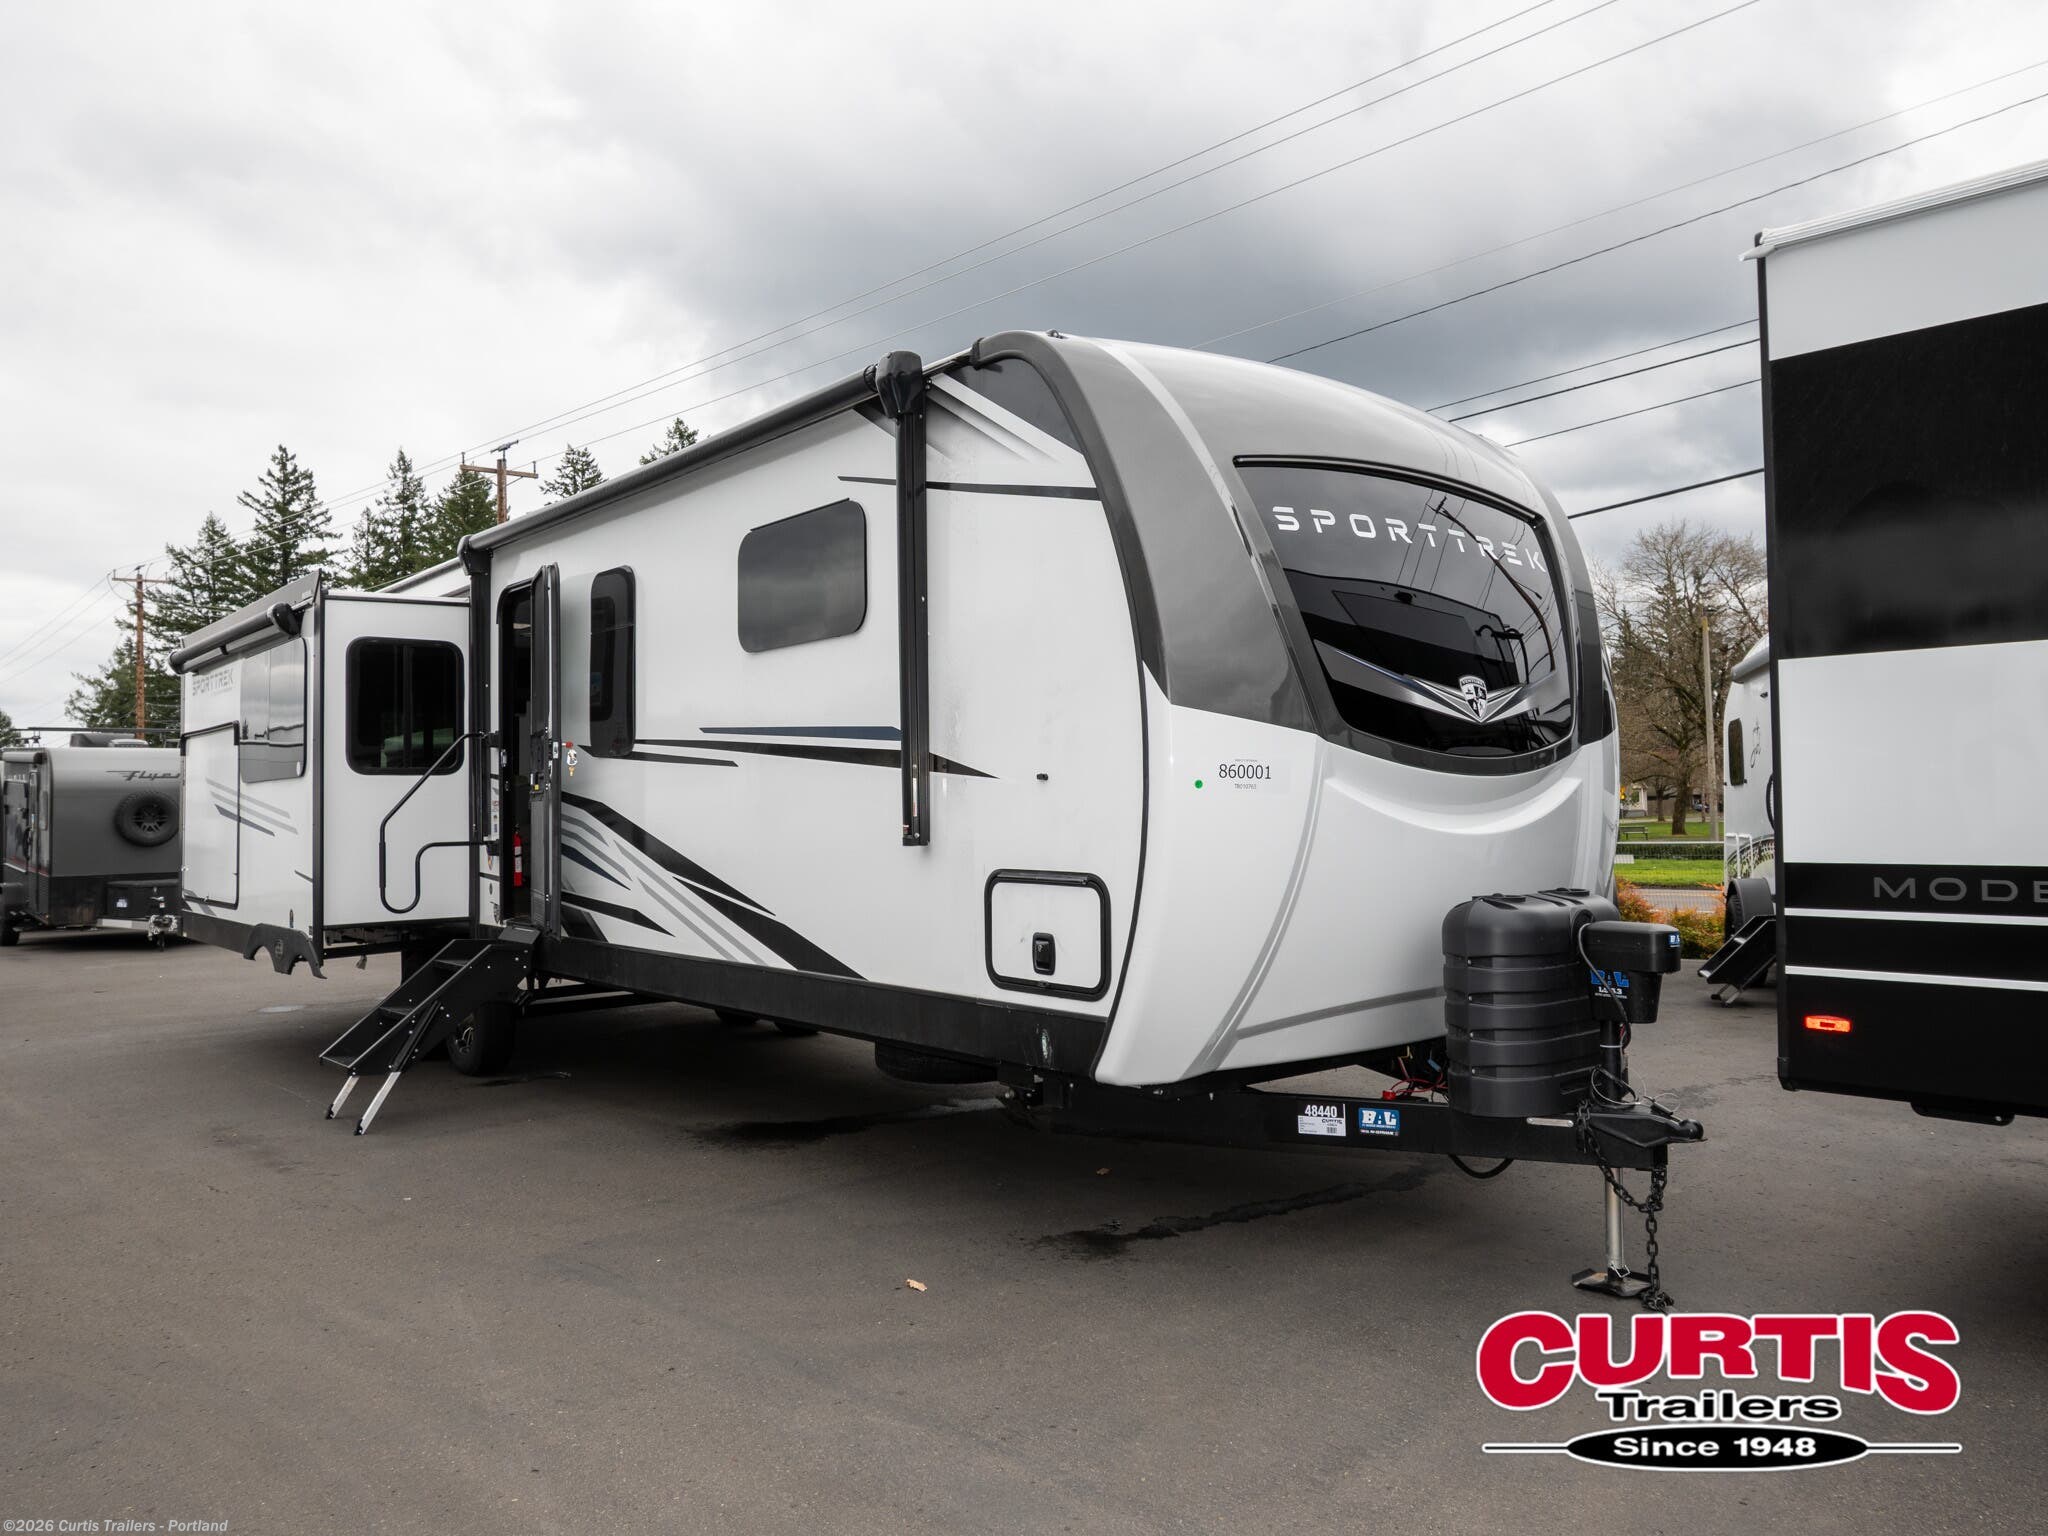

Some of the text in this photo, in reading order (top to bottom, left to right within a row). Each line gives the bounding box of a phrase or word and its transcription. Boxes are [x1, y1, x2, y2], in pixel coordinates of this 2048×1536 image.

[1272, 506, 1547, 573] SPORTTREK
[1218, 763, 1272, 780] 860001
[1305, 1105, 1337, 1117] 48440
